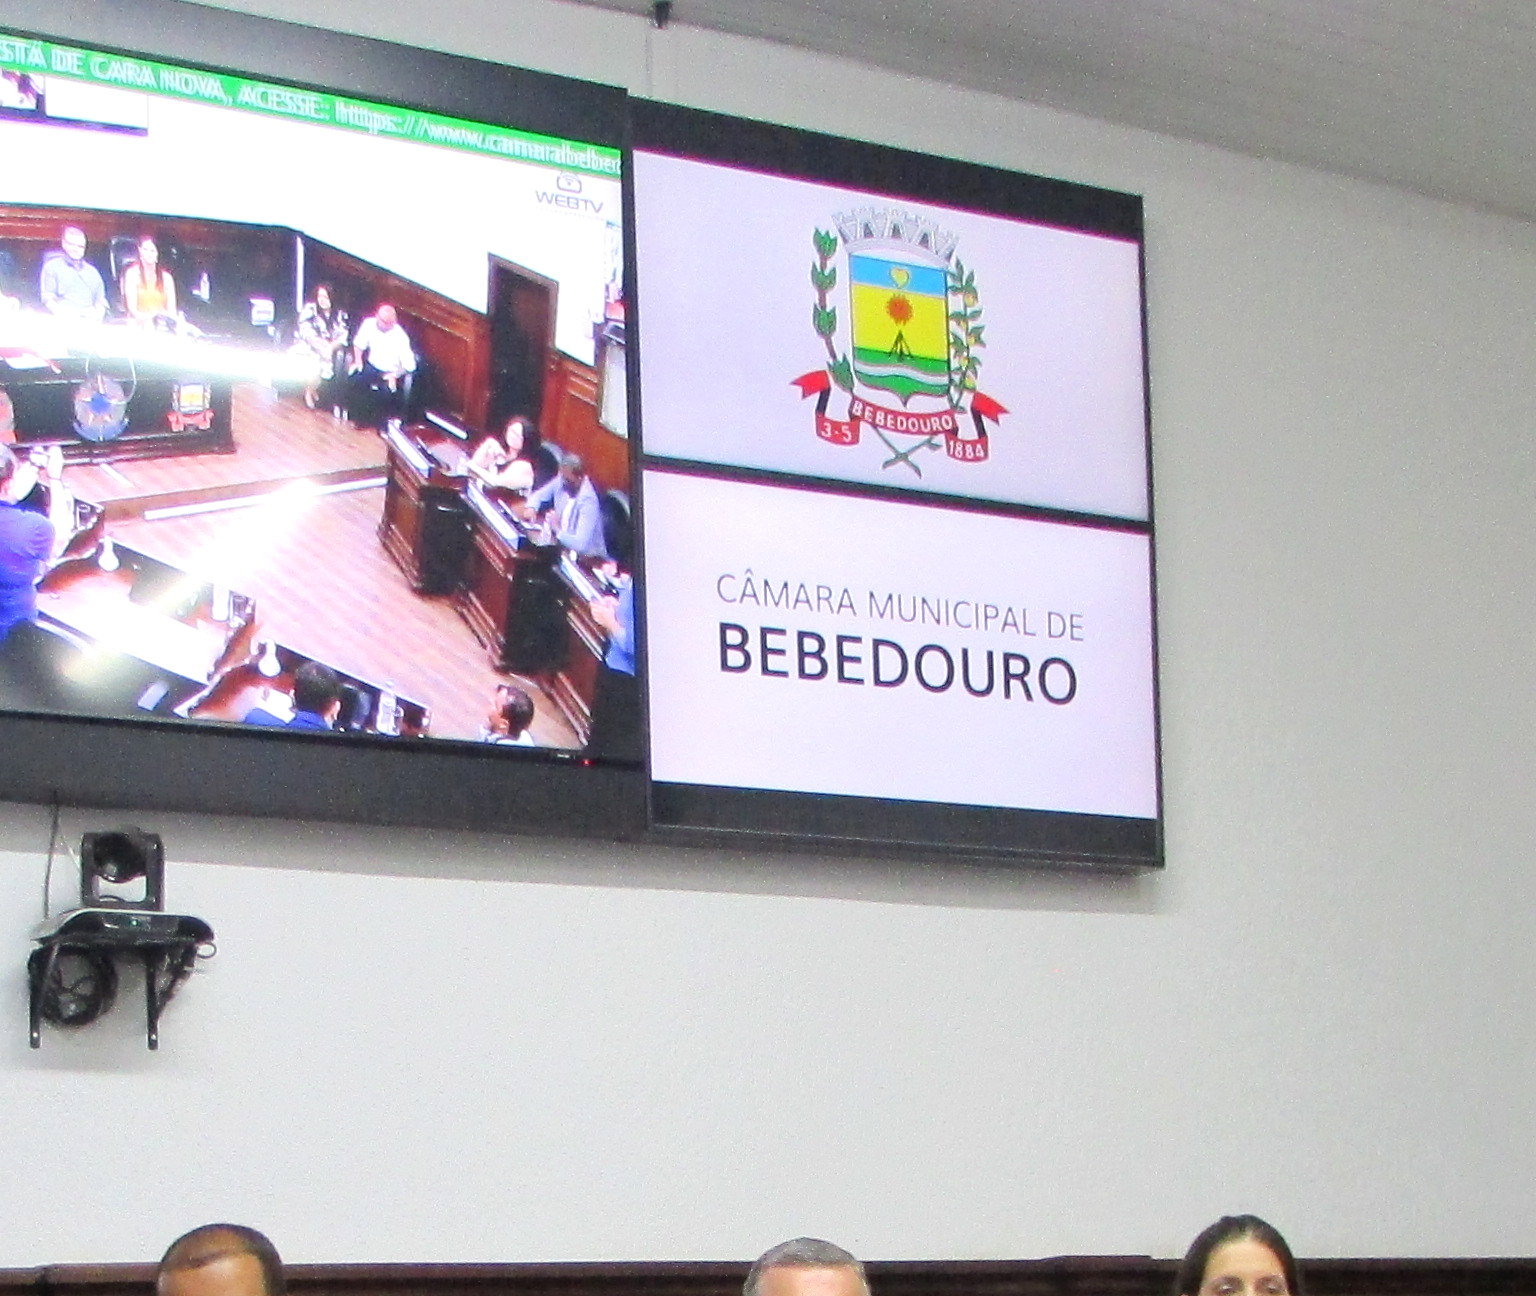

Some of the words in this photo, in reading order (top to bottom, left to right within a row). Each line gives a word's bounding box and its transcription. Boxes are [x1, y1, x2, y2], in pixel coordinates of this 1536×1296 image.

[51, 47, 85, 77] DE
[88, 55, 156, 87] CARA
[535, 190, 604, 214] WEBTV
[852, 400, 953, 432] BEBEDOURO
[820, 422, 852, 443] 3-5
[947, 440, 985, 459] 1884
[716, 568, 858, 617] CÂMARA
[868, 590, 1037, 637] MUNICIPAL
[1047, 611, 1085, 642] DE
[718, 622, 1078, 706] BEBEDOURO
